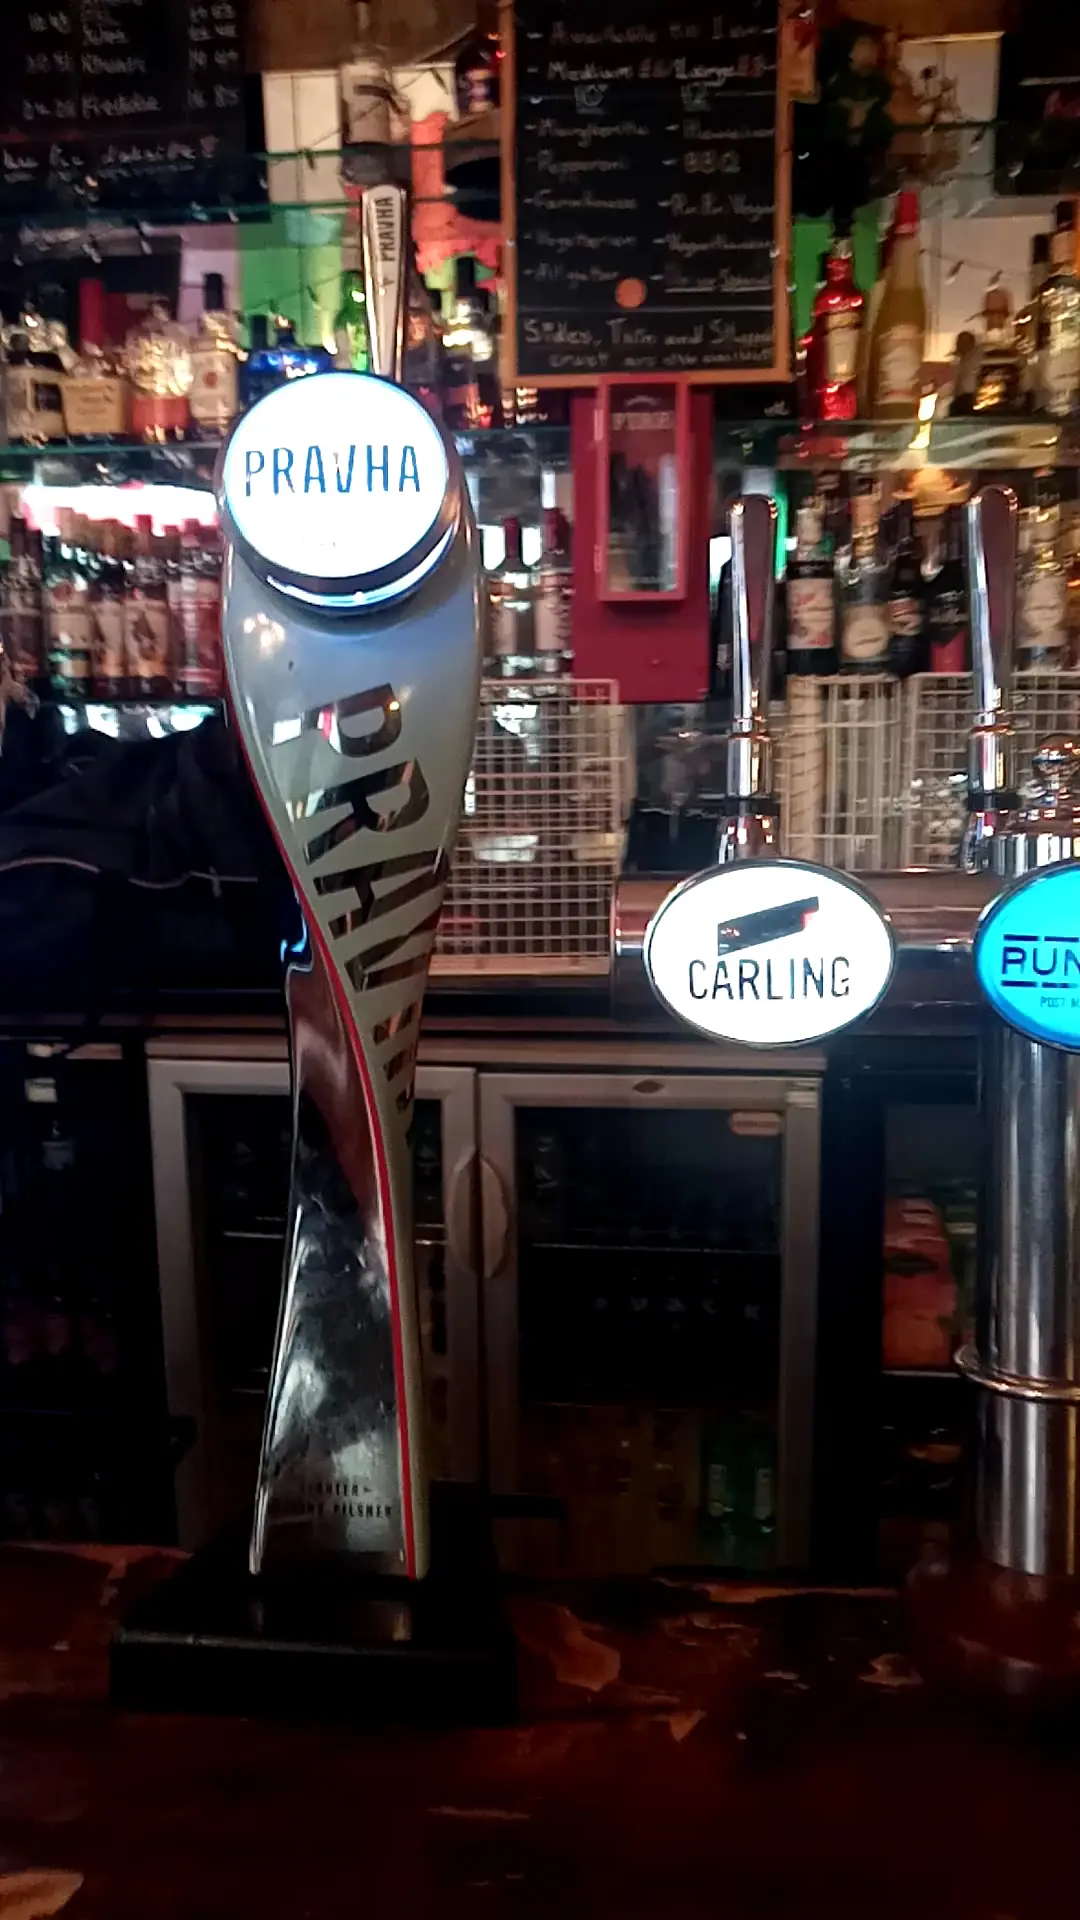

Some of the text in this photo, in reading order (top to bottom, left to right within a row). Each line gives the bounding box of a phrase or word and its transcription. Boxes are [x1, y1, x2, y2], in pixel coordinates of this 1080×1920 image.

[245, 444, 421, 497] PRAVHA
[688, 956, 850, 1001] CARLING
[332, 1503, 393, 1519] PILSNER
